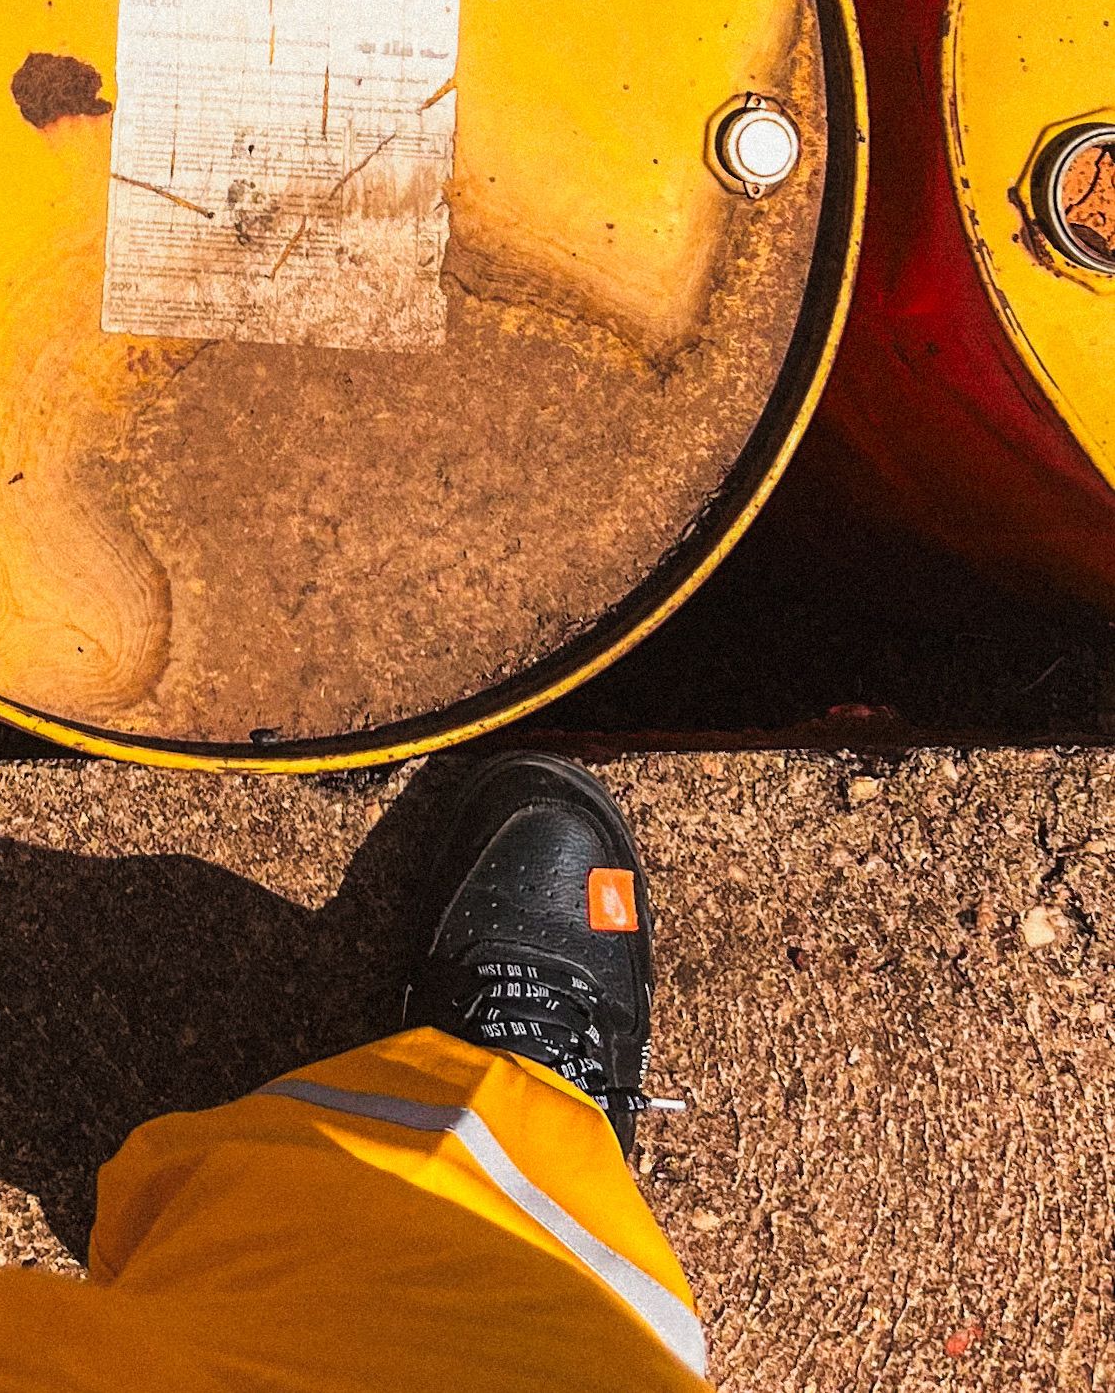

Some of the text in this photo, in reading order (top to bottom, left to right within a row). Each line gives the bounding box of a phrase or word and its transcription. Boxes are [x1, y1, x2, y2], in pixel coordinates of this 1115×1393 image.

[111, 281, 139, 292] 2091
[477, 964, 539, 979] JUST DO IT
[489, 981, 549, 997] JUST DO IT
[480, 1021, 542, 1038] JUST DO IT
